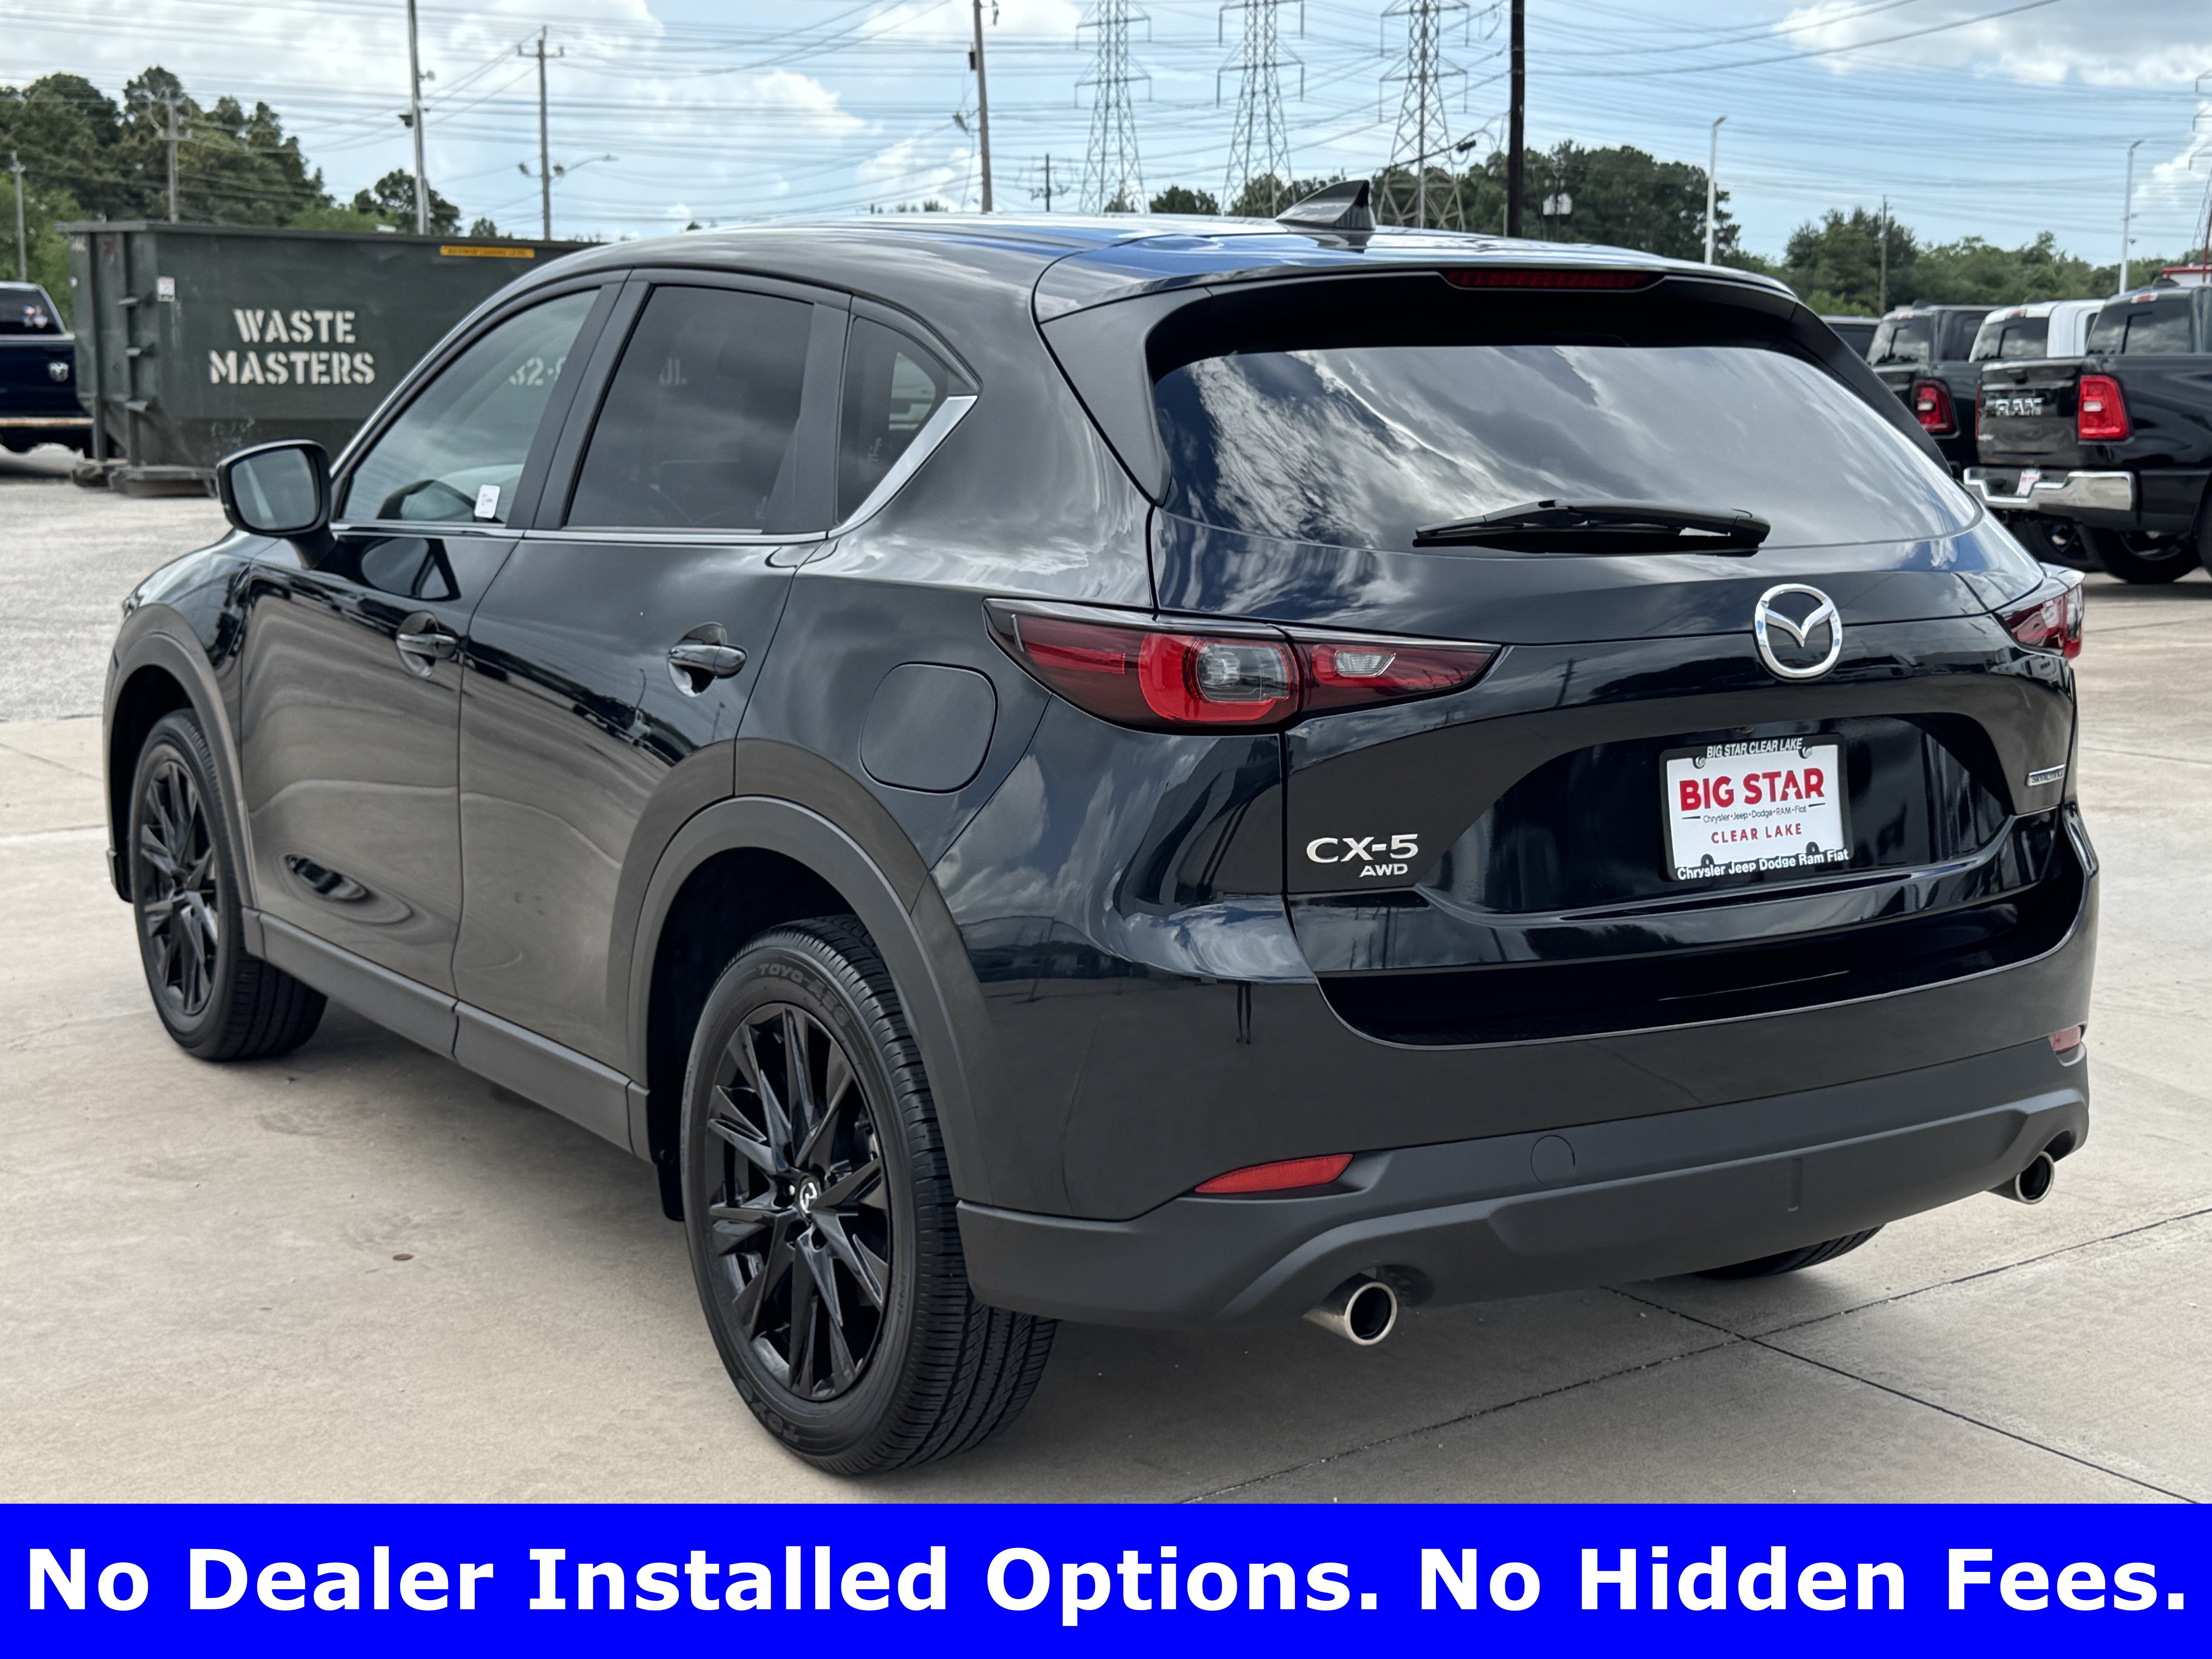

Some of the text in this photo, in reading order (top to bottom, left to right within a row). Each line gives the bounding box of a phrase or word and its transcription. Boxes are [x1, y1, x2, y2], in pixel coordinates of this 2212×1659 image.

[234, 309, 356, 343] WASTE
[209, 349, 376, 384] MASTERS
[1707, 737, 1803, 758] BIG STAR CLEAR LAKE
[1680, 768, 1824, 811] BIG STAR
[1307, 833, 1418, 863] CX-5
[1711, 823, 1802, 844] CLEAR LAKE
[1359, 863, 1408, 878] AWD
[1677, 849, 1850, 880] Chrysler Jeep Dodge Ram Fiat
[758, 963, 804, 983] TOYO
